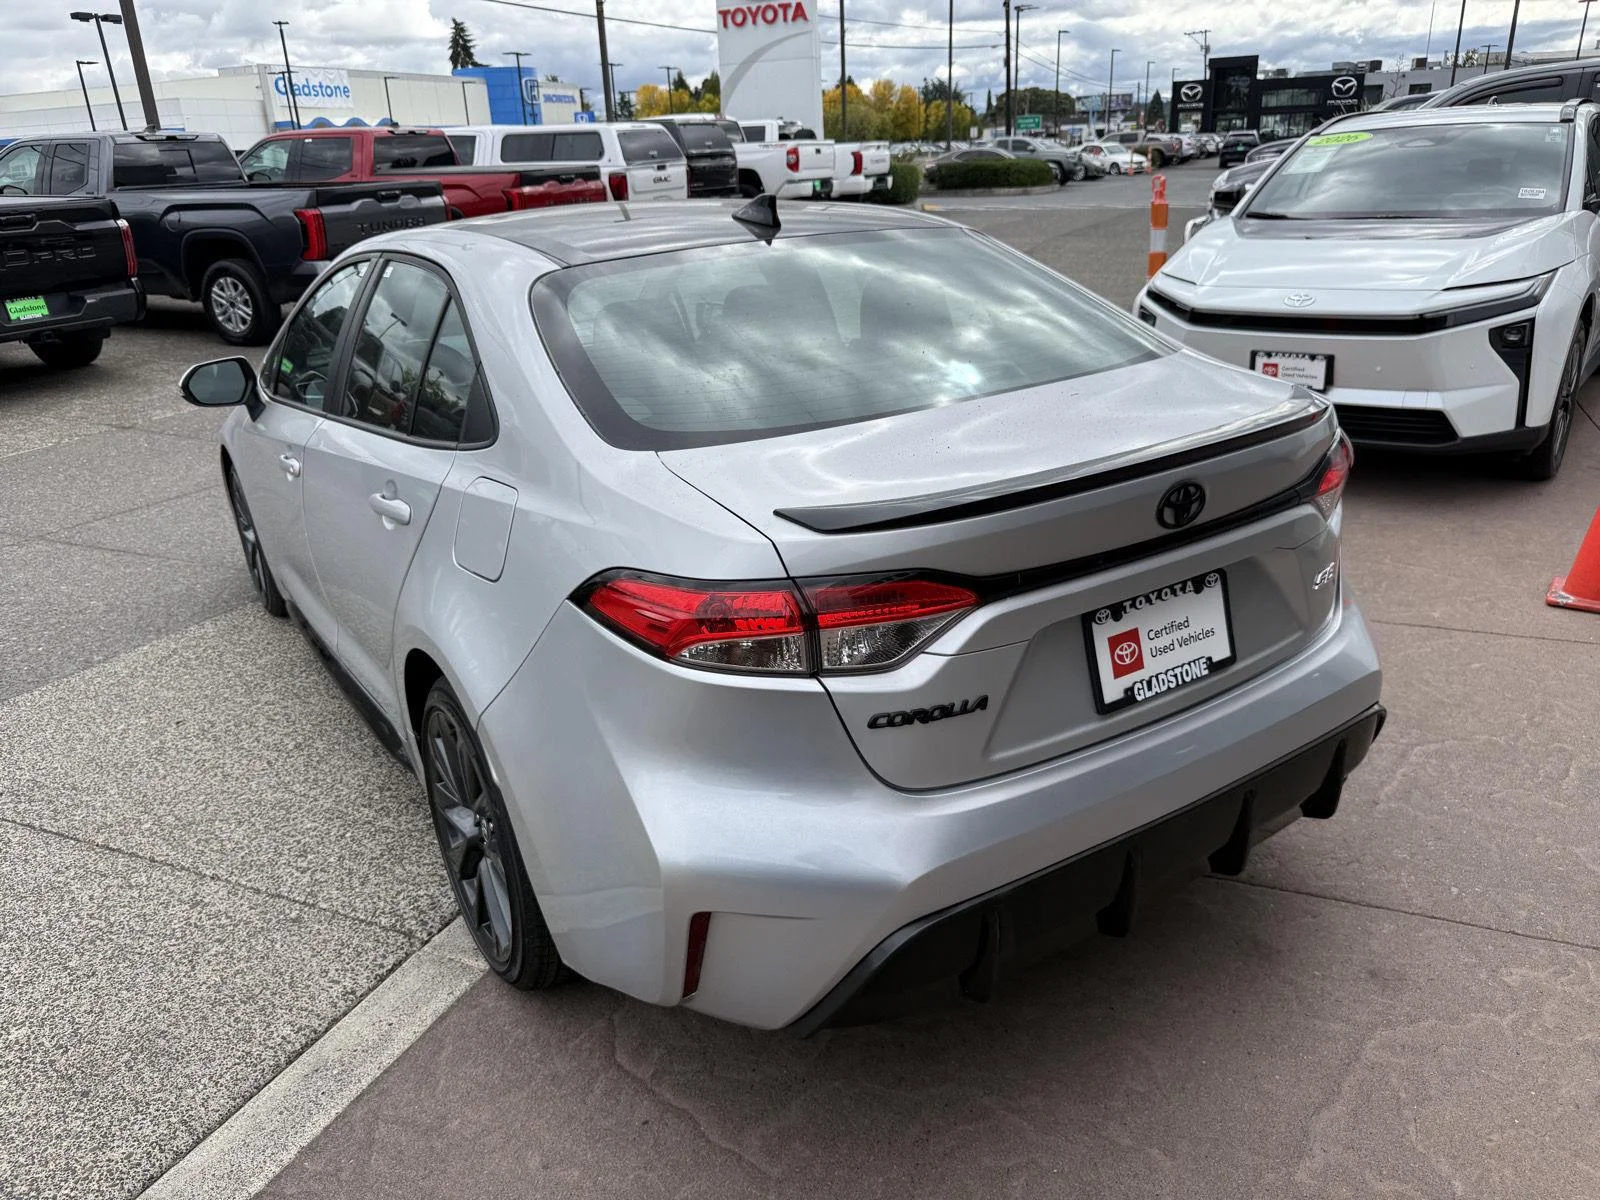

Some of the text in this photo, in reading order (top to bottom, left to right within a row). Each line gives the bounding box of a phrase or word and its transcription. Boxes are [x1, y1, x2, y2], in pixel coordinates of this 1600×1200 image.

[719, 1, 808, 29] TOYOTA
[274, 76, 350, 98] Gadstone
[653, 175, 672, 184] GMC
[356, 216, 426, 236] TUNDRA
[9, 304, 46, 314] Gladstone
[1271, 352, 1310, 360] TOYOTA
[1123, 580, 1196, 614] TOYOTA
[1147, 616, 1190, 641] Certified
[1149, 627, 1216, 658] Used Vehicles
[1133, 656, 1210, 702] GLADSTONE
[866, 694, 989, 730] COROLLA
